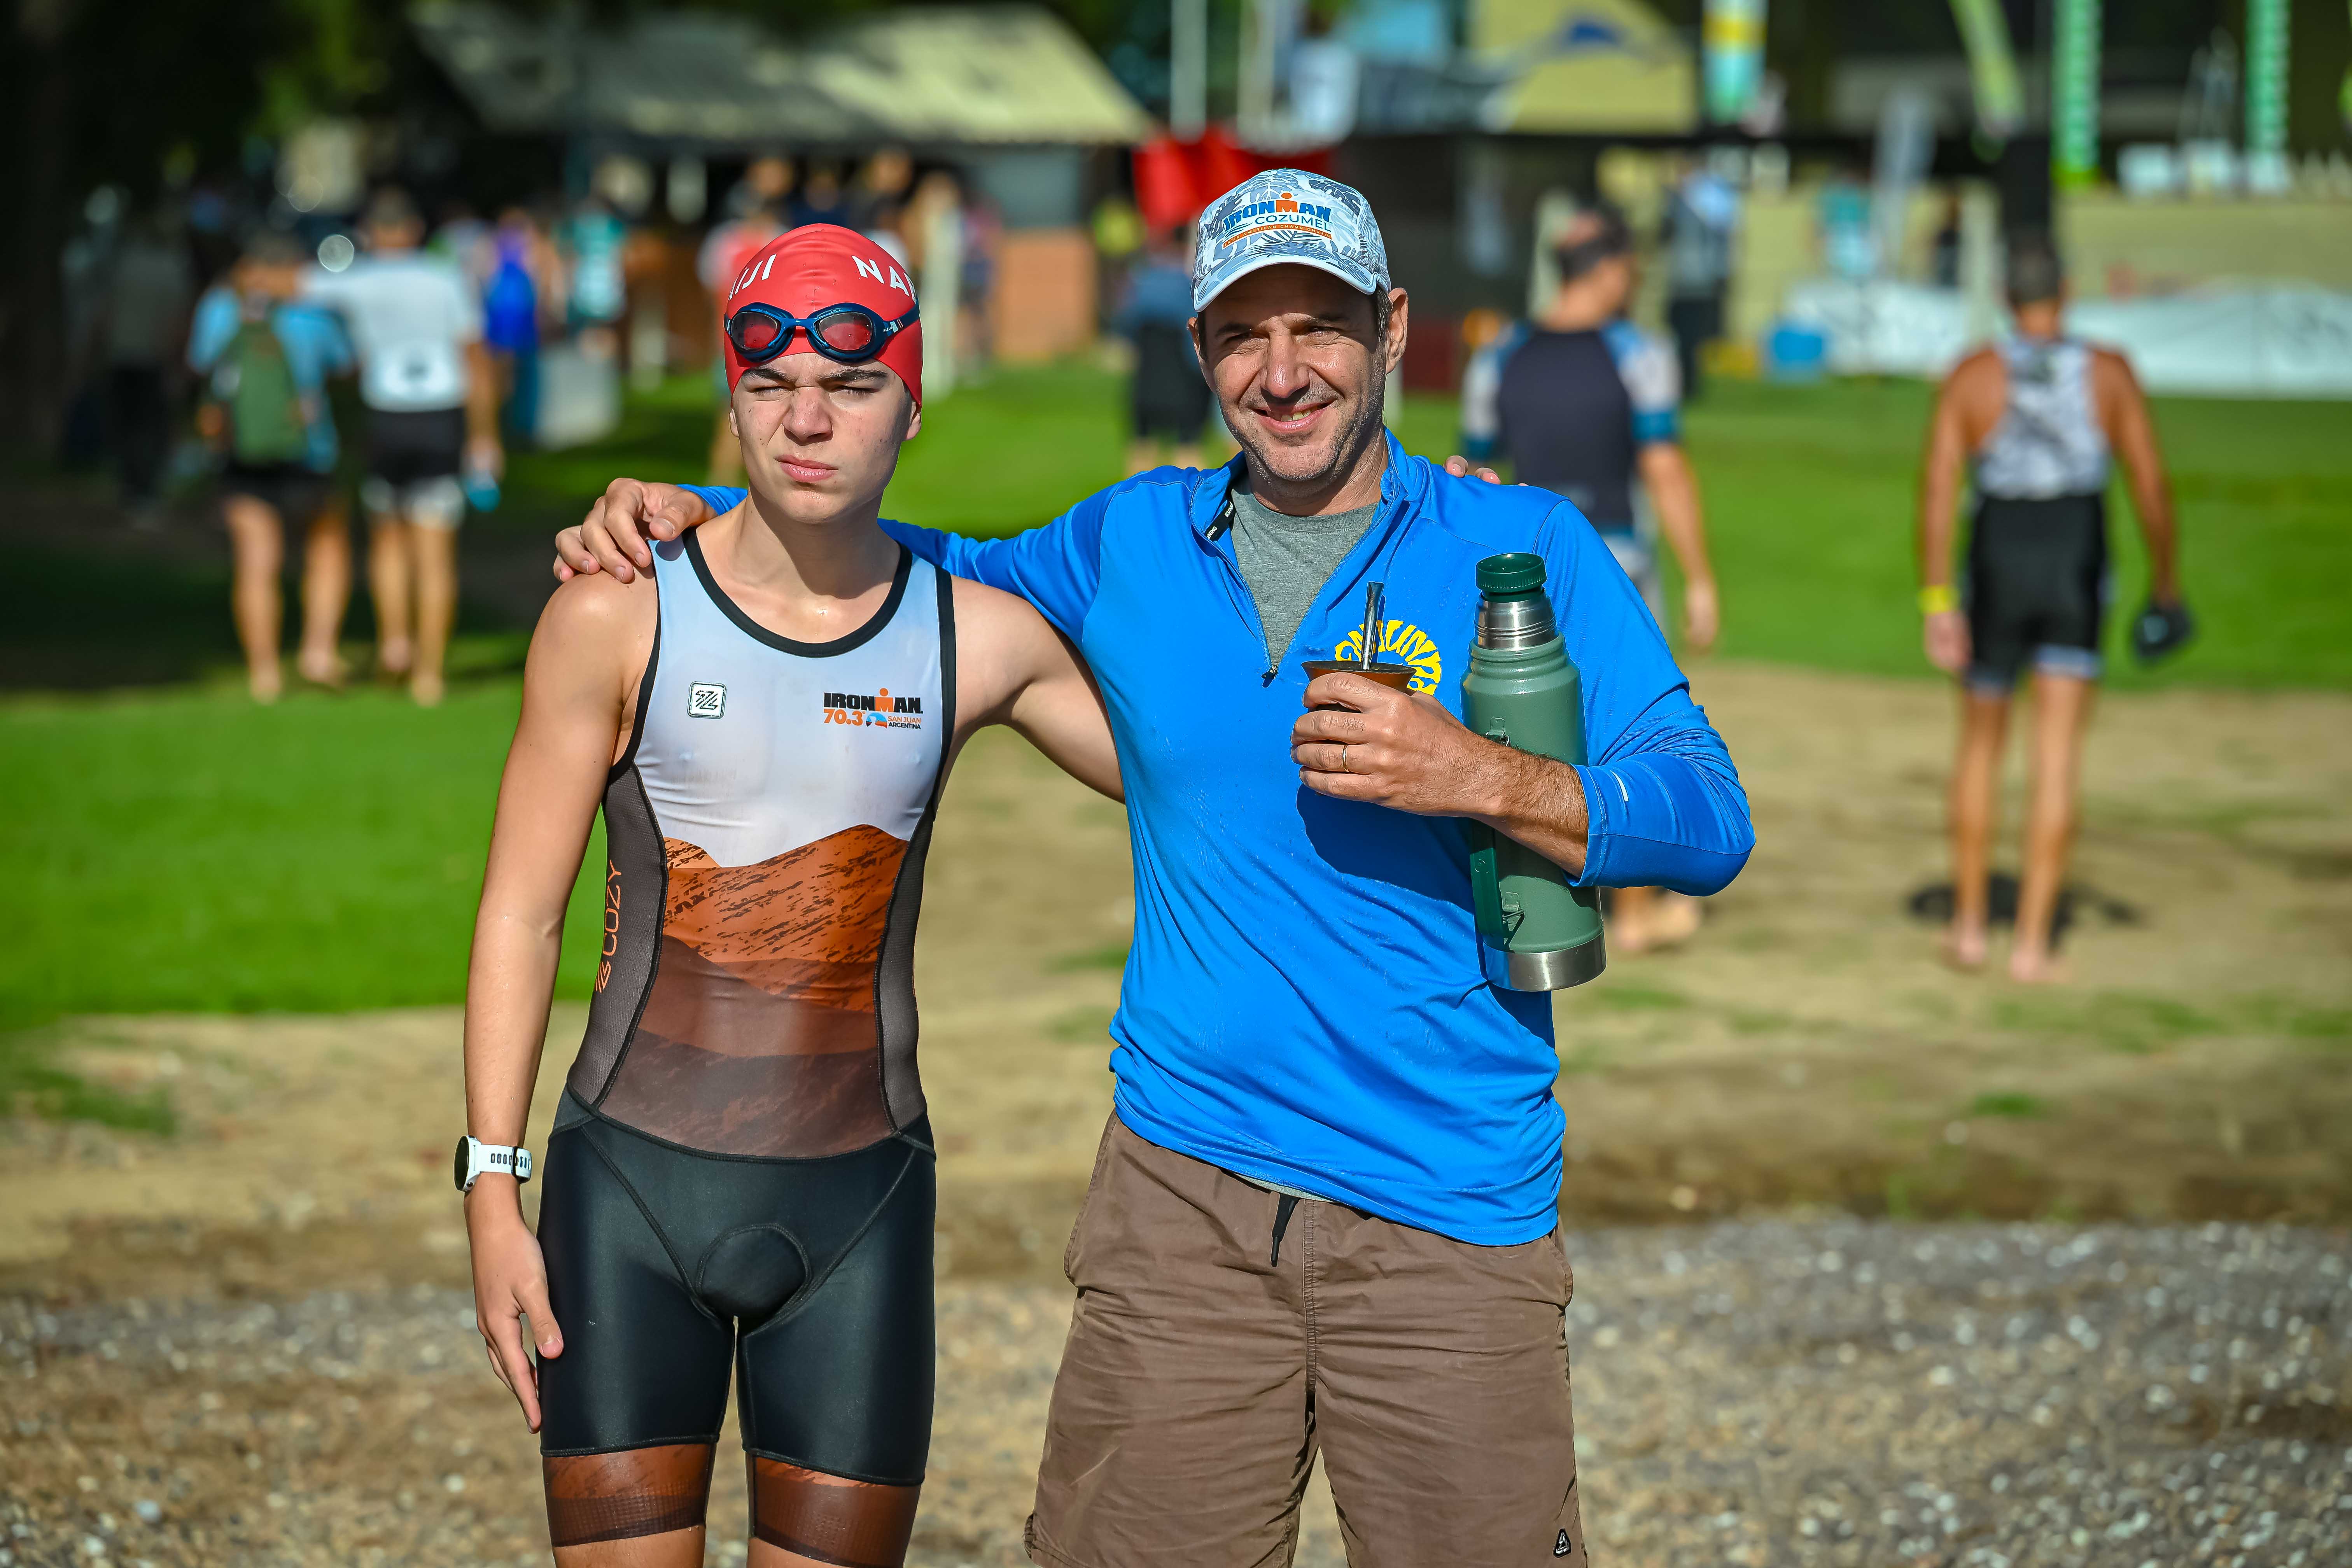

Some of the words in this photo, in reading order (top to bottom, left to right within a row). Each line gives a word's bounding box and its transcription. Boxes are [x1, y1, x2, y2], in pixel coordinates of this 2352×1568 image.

[1223, 192, 1332, 231] IRONMAN
[1255, 215, 1332, 232] COZUMEL
[1224, 236, 1241, 247] LATIN
[1243, 225, 1277, 236] AMERICAN
[1280, 225, 1331, 238] CHAMPIONSHIP
[823, 688, 923, 714] IRONMAN
[823, 709, 864, 726] 70.3
[603, 859, 621, 956] COZY
